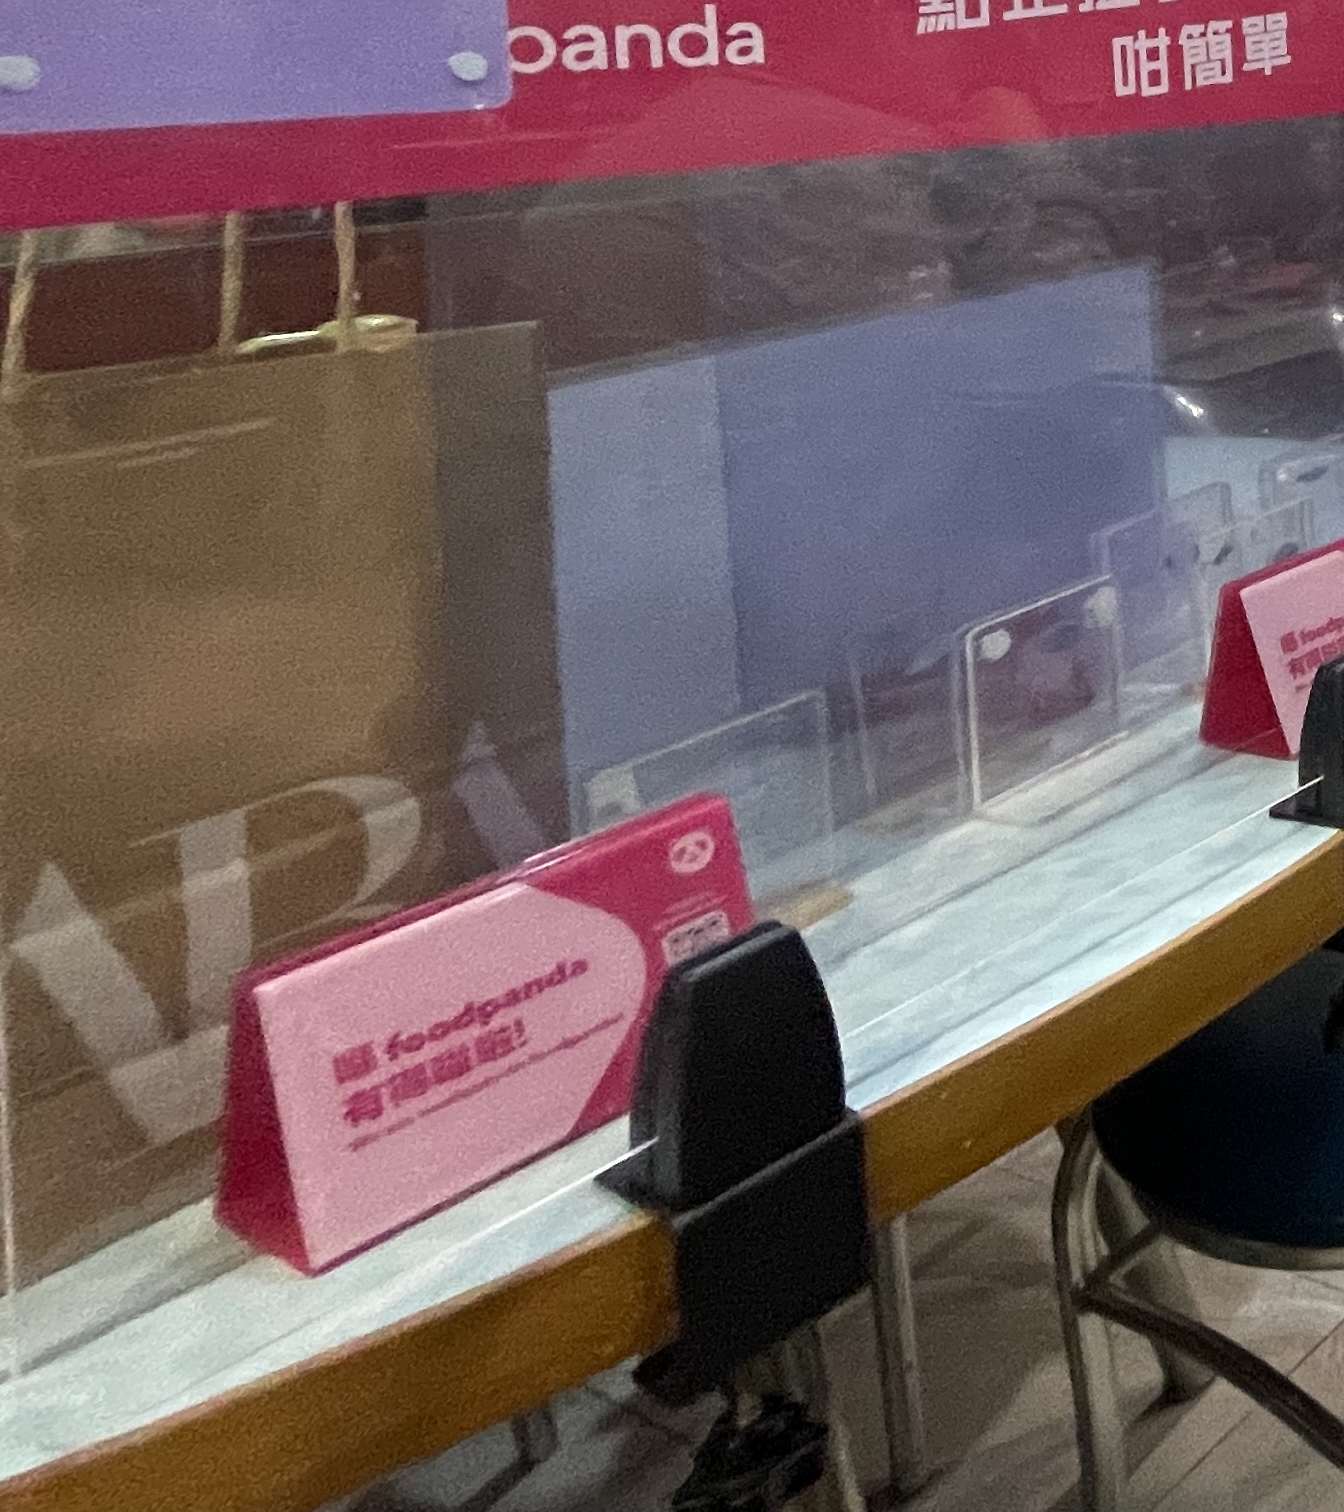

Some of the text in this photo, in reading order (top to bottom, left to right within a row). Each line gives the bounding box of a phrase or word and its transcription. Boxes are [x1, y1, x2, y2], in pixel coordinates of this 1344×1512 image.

[1112, 11, 1293, 99] 咁簡單
[384, 957, 590, 1061] foodpanda
